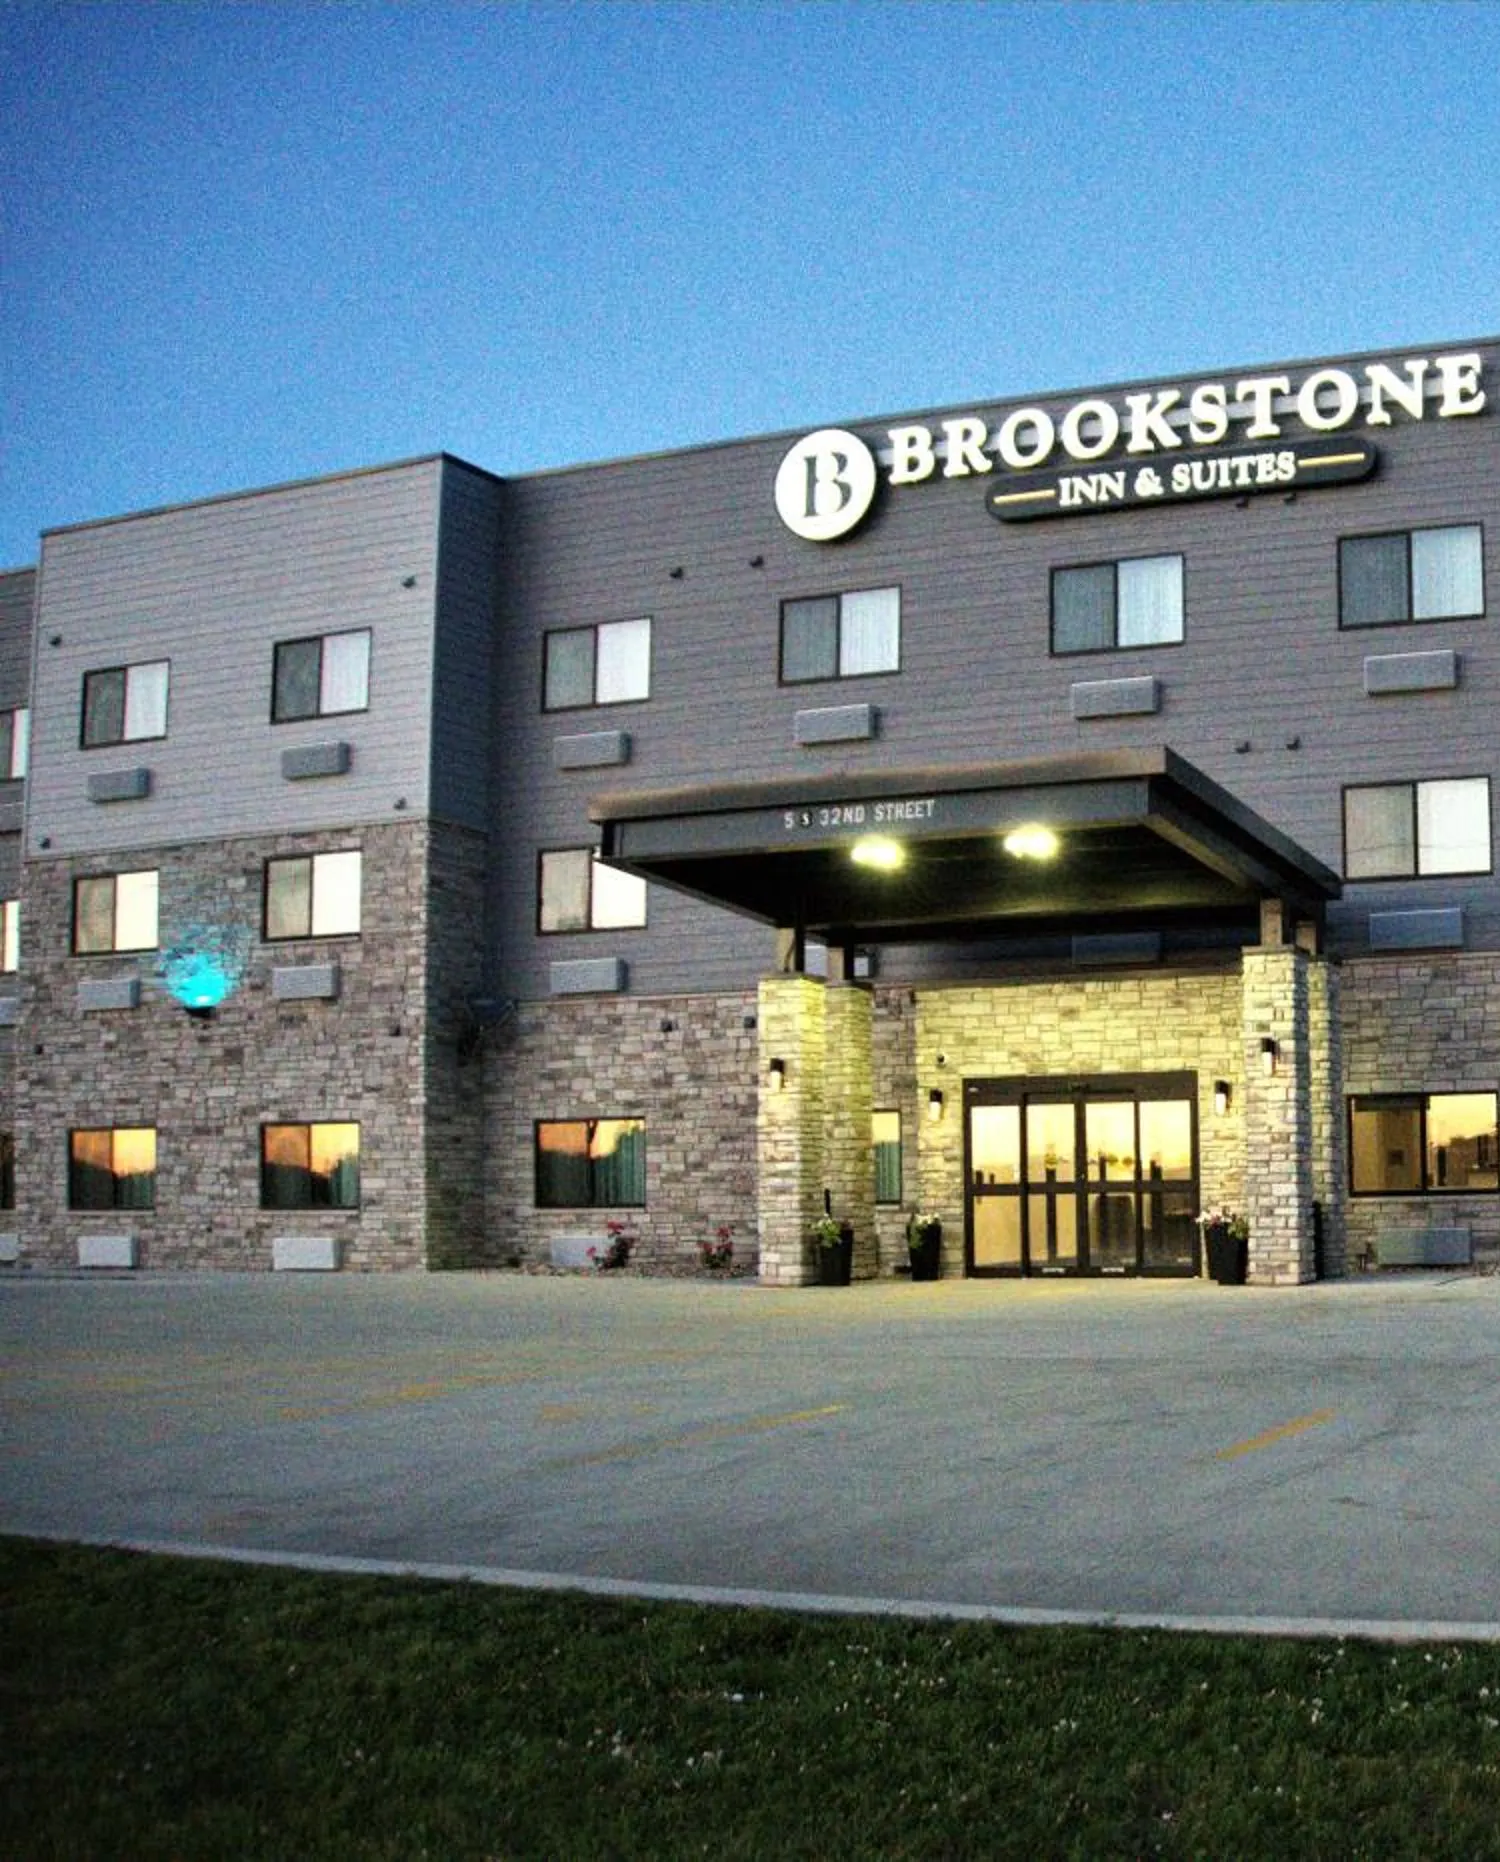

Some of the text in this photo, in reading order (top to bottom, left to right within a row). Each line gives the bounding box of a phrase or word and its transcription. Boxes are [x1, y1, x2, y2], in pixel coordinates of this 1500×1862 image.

[887, 353, 1487, 486] BROOKSTONE
[803, 451, 852, 518] B
[1059, 451, 1296, 507] INN & SUITES
[820, 805, 865, 827] 32ND
[875, 799, 935, 822] STREET
